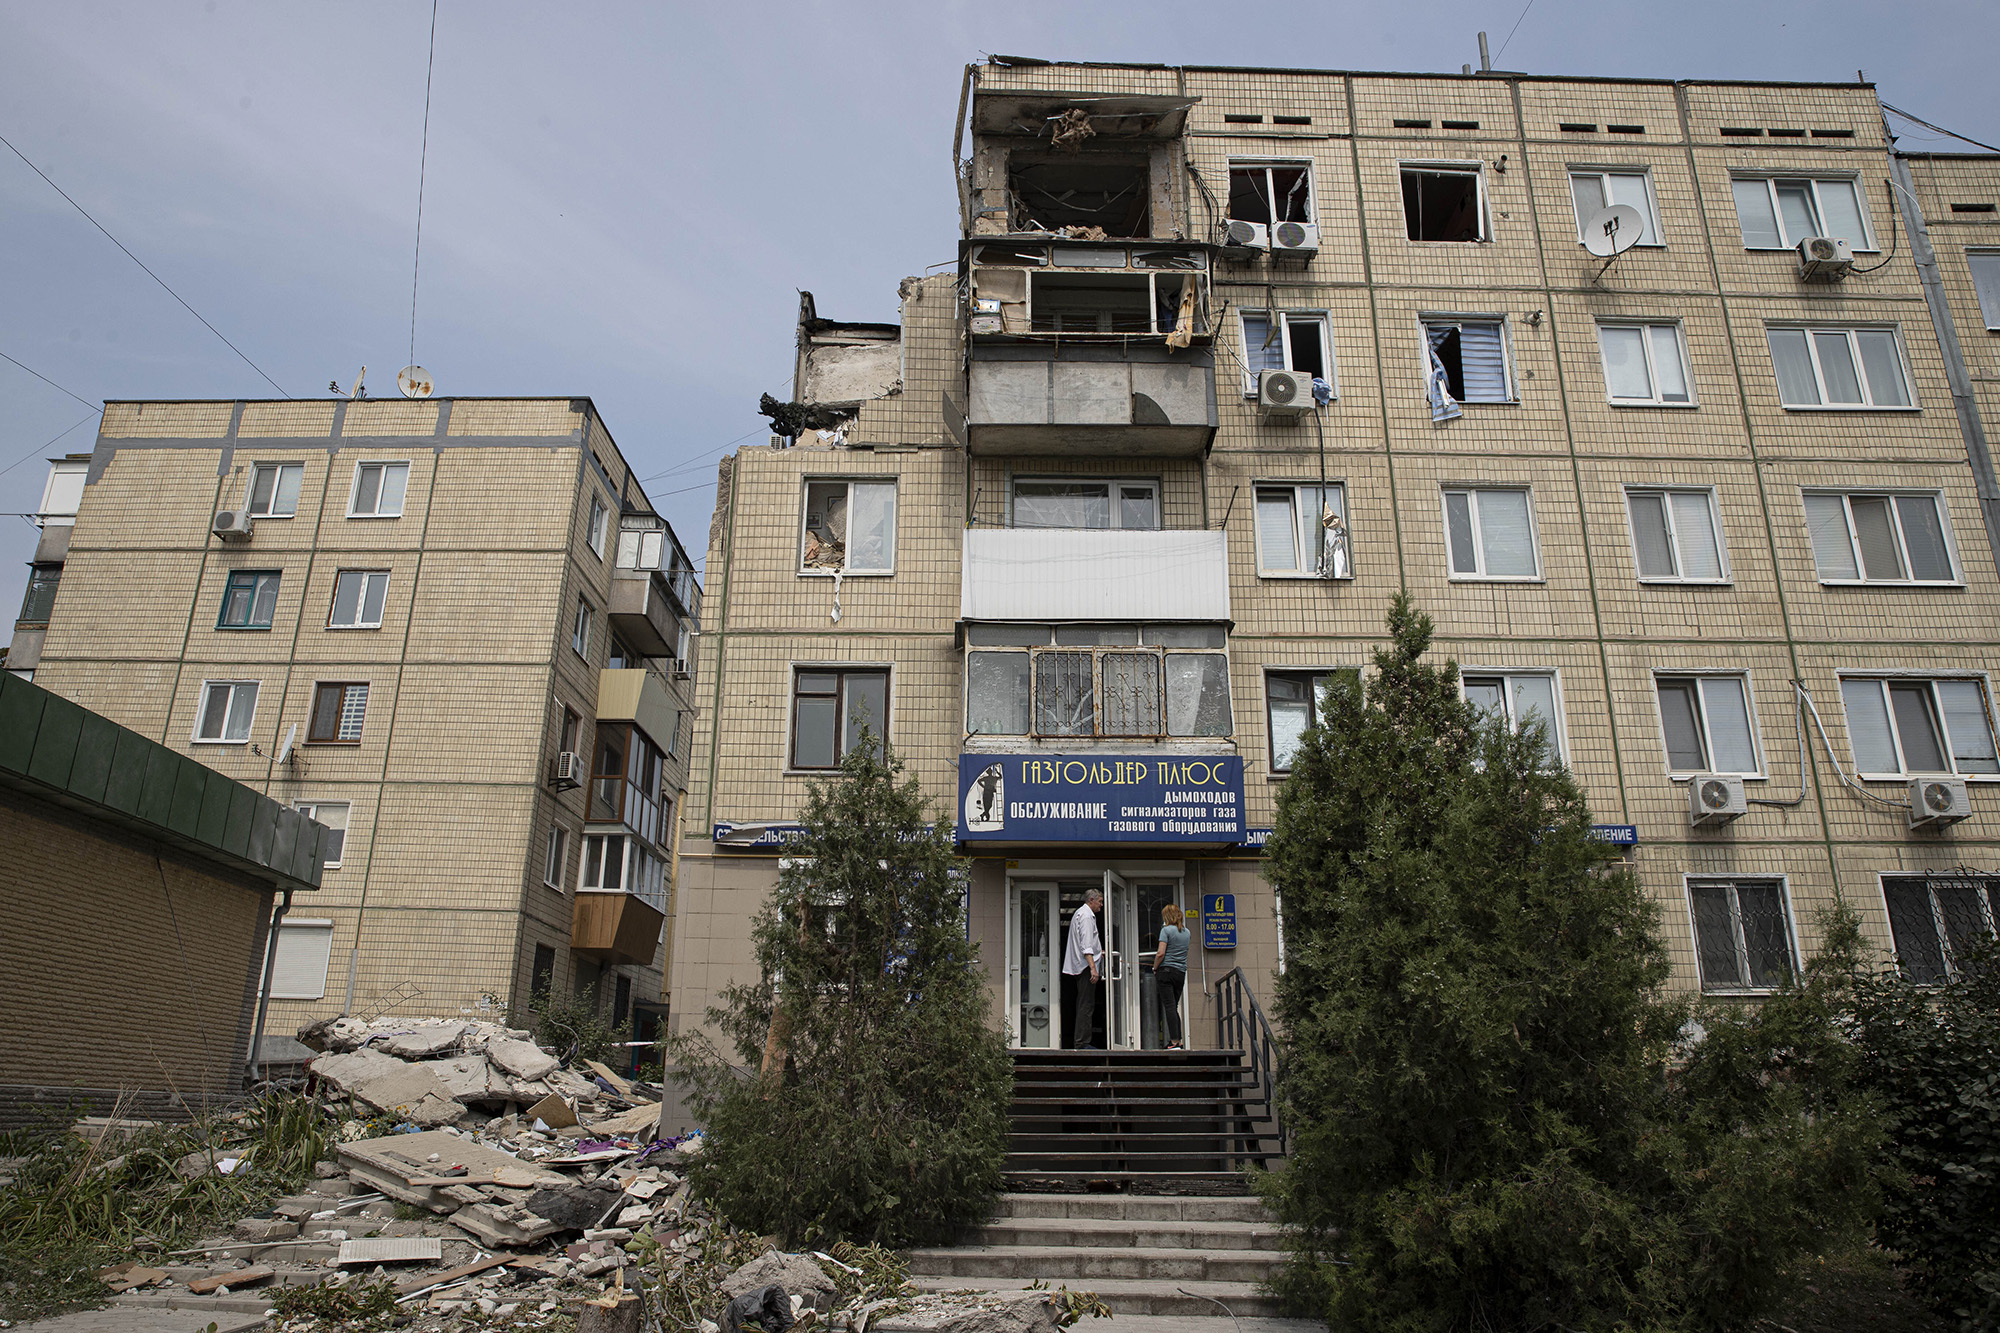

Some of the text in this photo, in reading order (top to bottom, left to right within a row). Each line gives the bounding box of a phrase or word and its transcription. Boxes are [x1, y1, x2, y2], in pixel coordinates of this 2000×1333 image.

[1022, 761, 1226, 785] ГАЗГОЛЬДЕР ПЛЮС
[1010, 802, 1107, 819] ОБСЛУЖИВАНИЕ
[1121, 806, 1237, 820] сигнализаторов газа
[1109, 819, 1237, 834] газового оборудования
